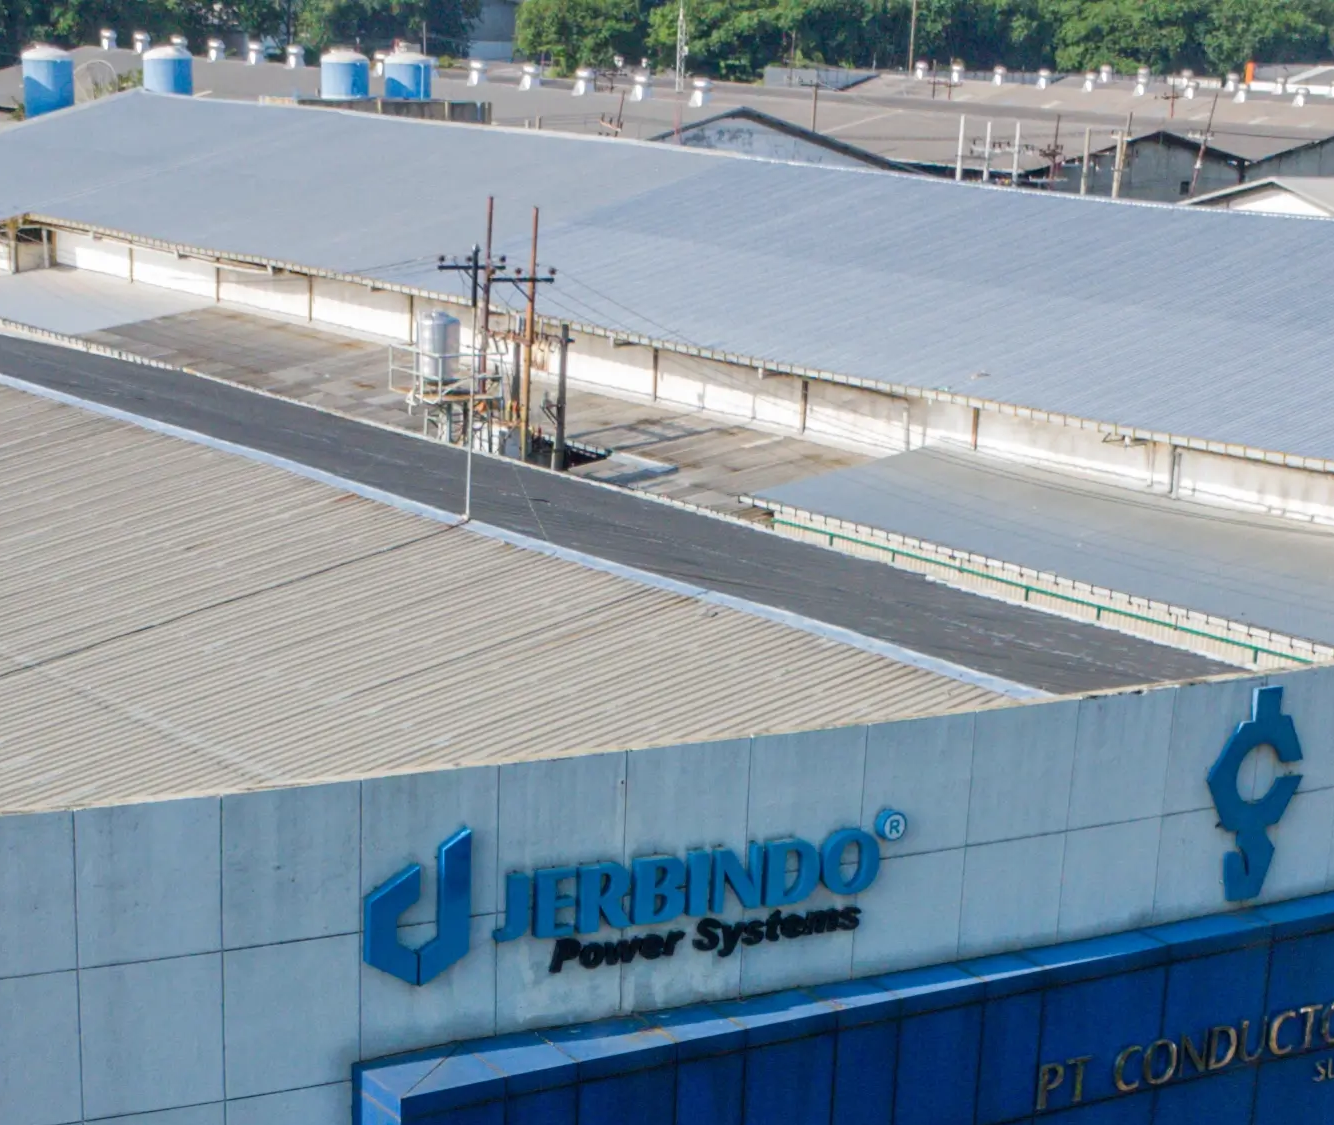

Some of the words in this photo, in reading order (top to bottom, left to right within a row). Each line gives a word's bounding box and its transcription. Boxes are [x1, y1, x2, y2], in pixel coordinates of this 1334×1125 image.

[492, 826, 880, 943] JERBINDO
[549, 929, 687, 974] Power
[691, 905, 862, 958] Systems
[1036, 1056, 1093, 1110] PT
